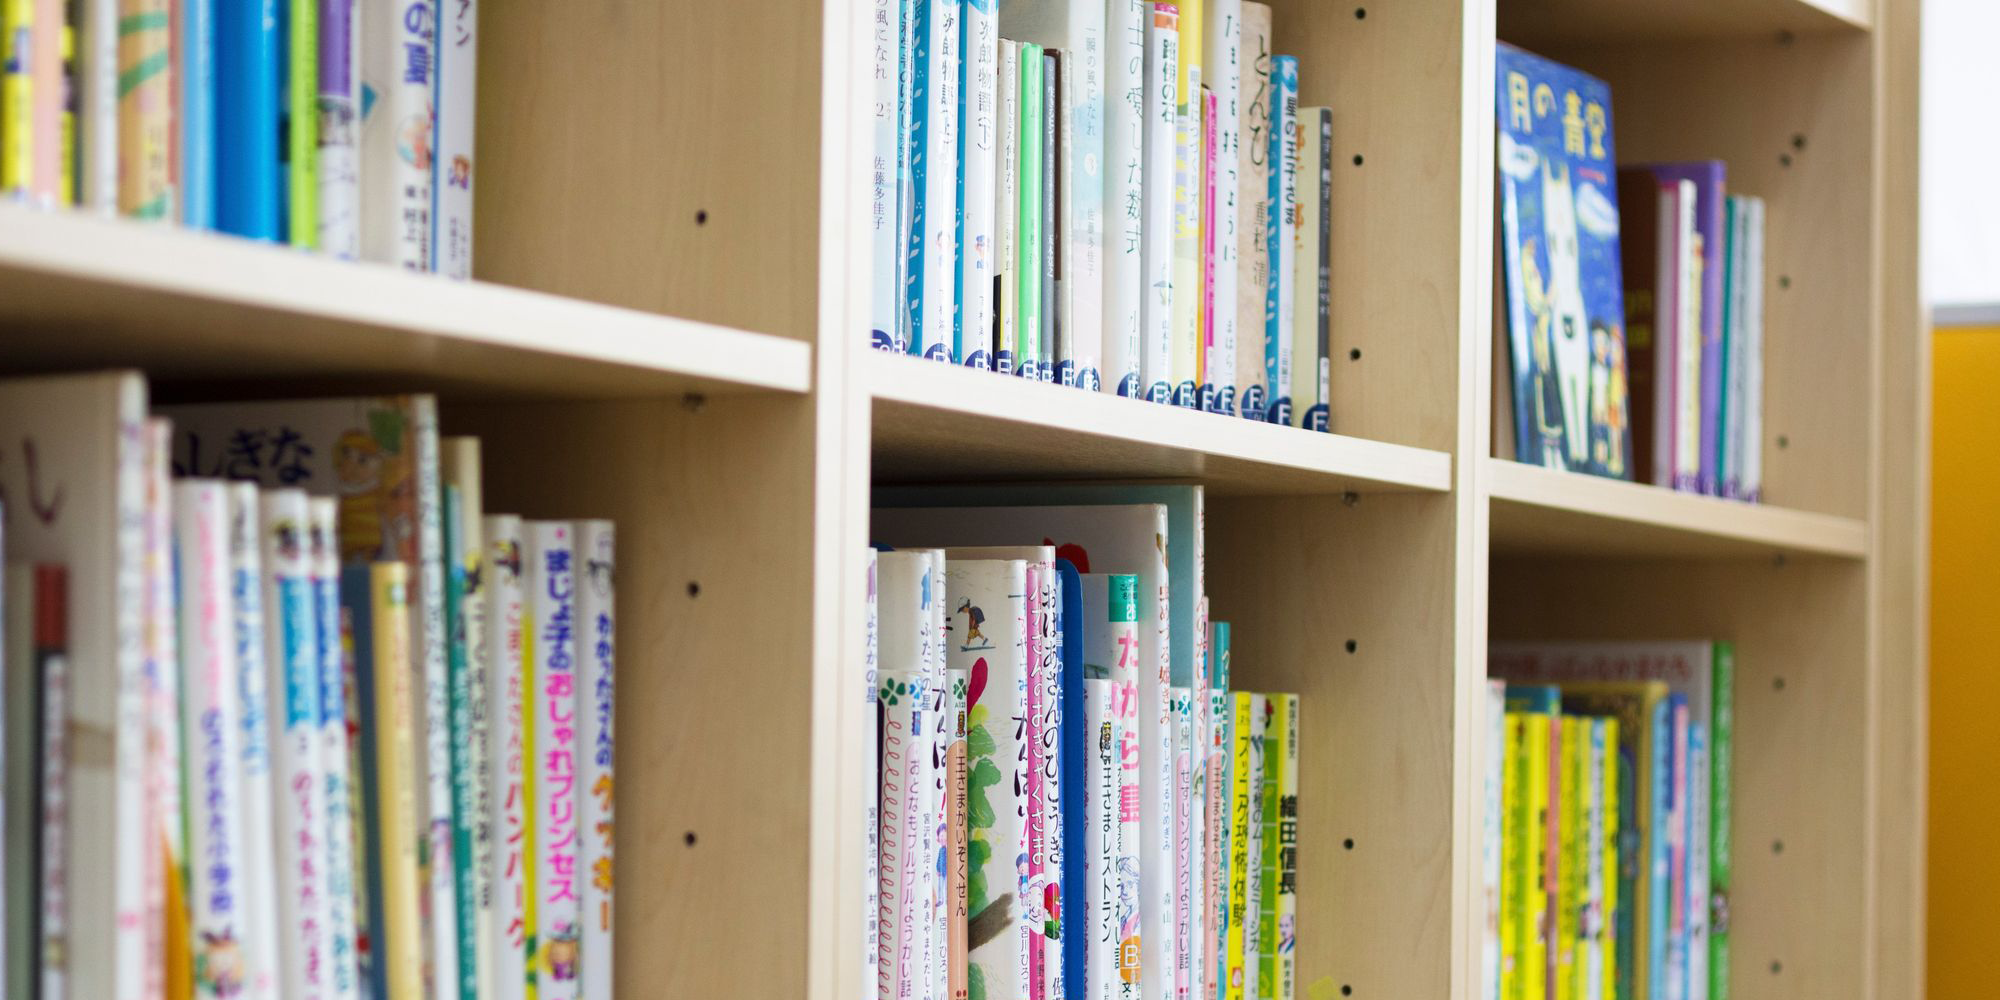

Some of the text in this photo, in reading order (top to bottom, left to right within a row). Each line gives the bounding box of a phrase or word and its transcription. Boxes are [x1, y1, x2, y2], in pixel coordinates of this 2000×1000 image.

[1117, 629, 1141, 823] たから島
[956, 756, 967, 917] 王さまかいぞくせん
[1279, 795, 1297, 896] 織田信長
